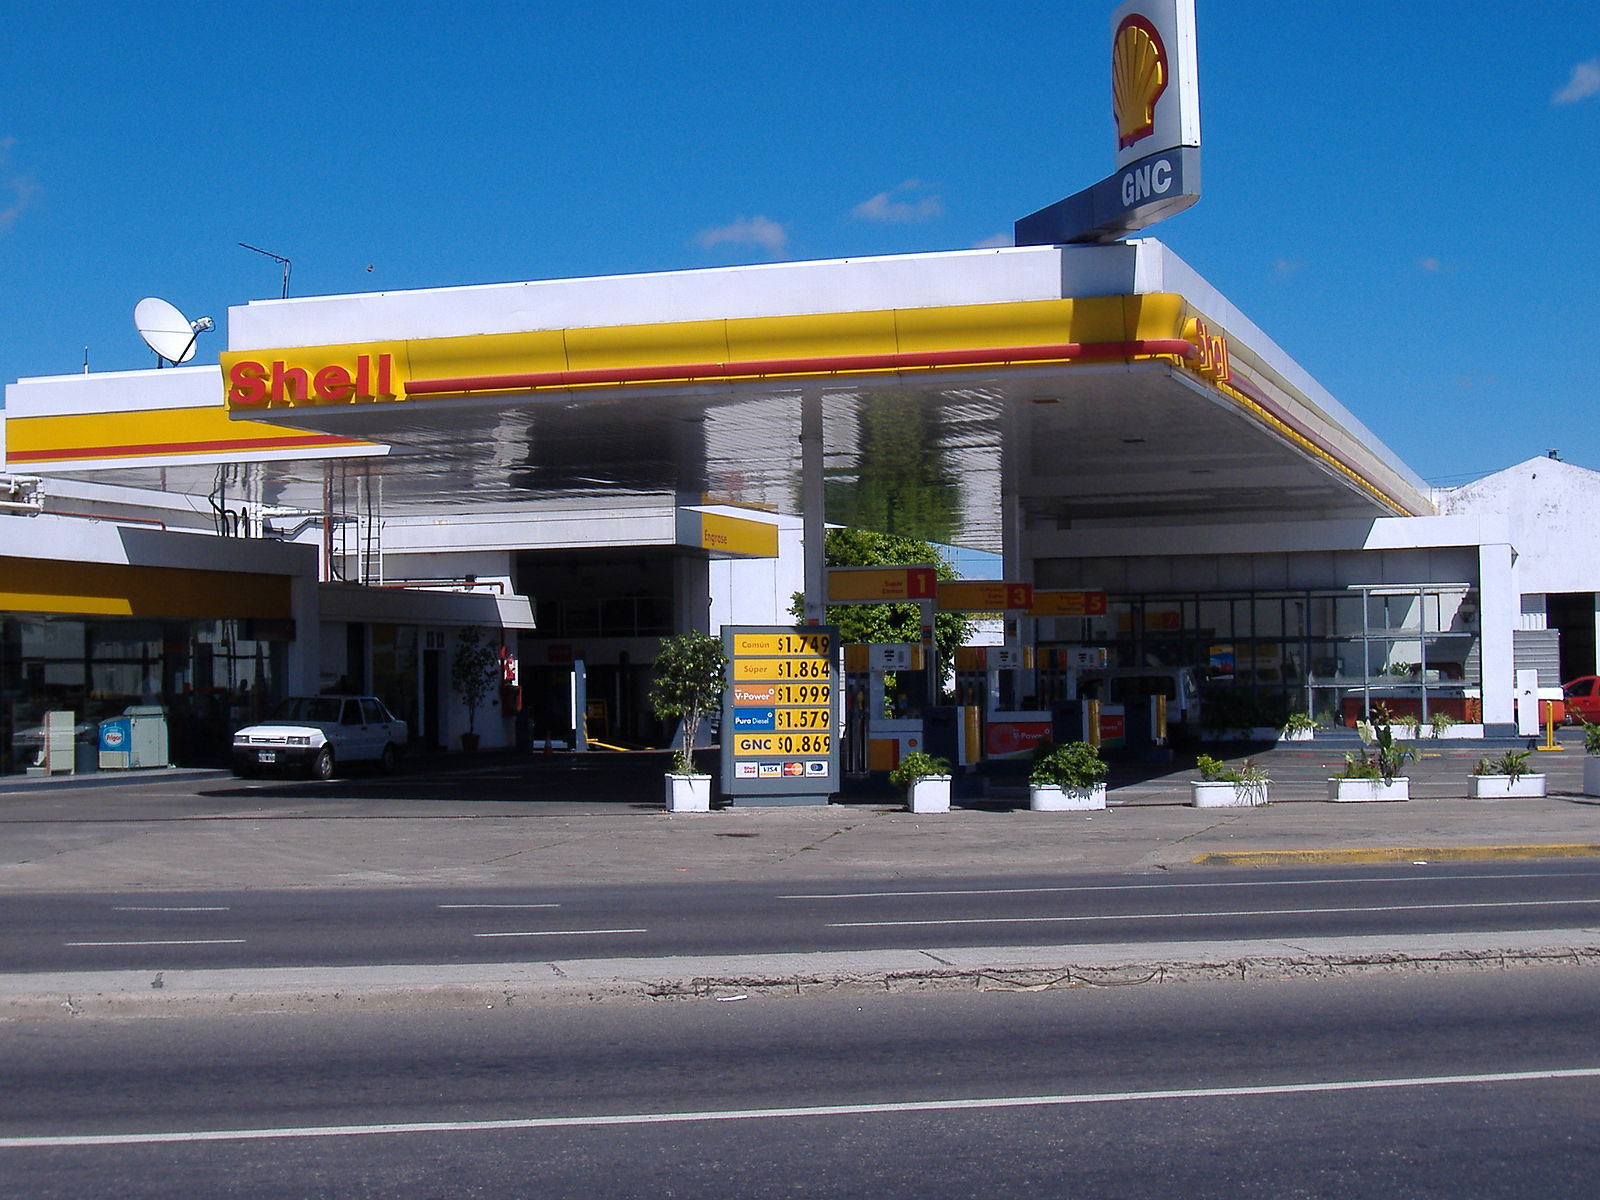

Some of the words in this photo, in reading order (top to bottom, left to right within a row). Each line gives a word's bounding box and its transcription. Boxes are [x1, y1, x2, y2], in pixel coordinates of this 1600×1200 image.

[1122, 159, 1172, 207] GNC
[228, 353, 394, 405] Shell
[917, 574, 926, 593] 1
[1013, 588, 1025, 605] 3
[1089, 596, 1101, 611] 5
[778, 636, 829, 653] $1.749
[744, 665, 768, 674] Súper
[778, 661, 830, 678] $1.864
[734, 692, 770, 700] V-Power
[778, 686, 830, 703] $1.999
[752, 717, 770, 725] Diesel
[778, 711, 829, 728] $1.579
[740, 739, 772, 750] GNC
[778, 736, 830, 753] $0.869
